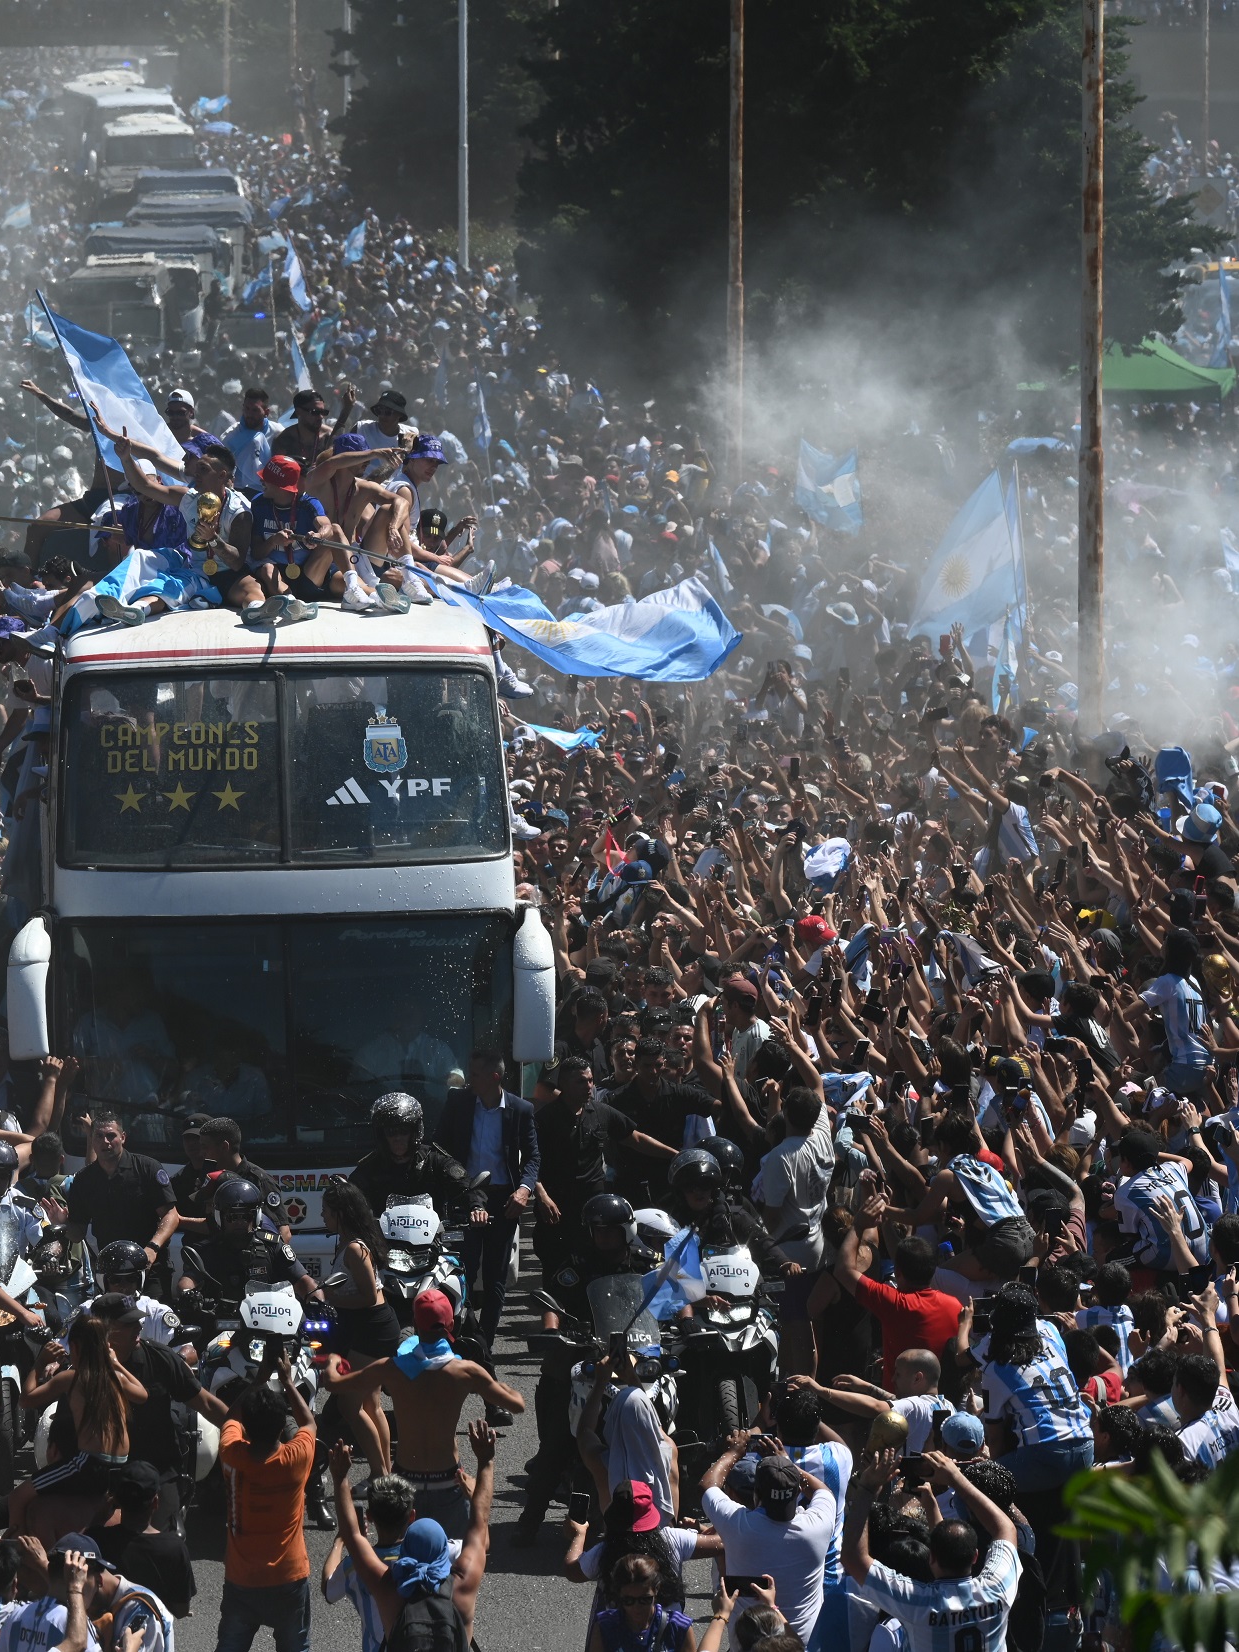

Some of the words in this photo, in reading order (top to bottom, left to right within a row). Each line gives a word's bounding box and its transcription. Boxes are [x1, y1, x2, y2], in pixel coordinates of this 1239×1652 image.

[100, 720, 259, 748] CAMPEONES
[107, 749, 156, 774] DEL
[168, 747, 258, 771] MUNDO
[378, 777, 452, 798] YPF
[1031, 1366, 1080, 1411] 10
[770, 1487, 794, 1500] BTS
[928, 1599, 1004, 1627] BATISTUTA
